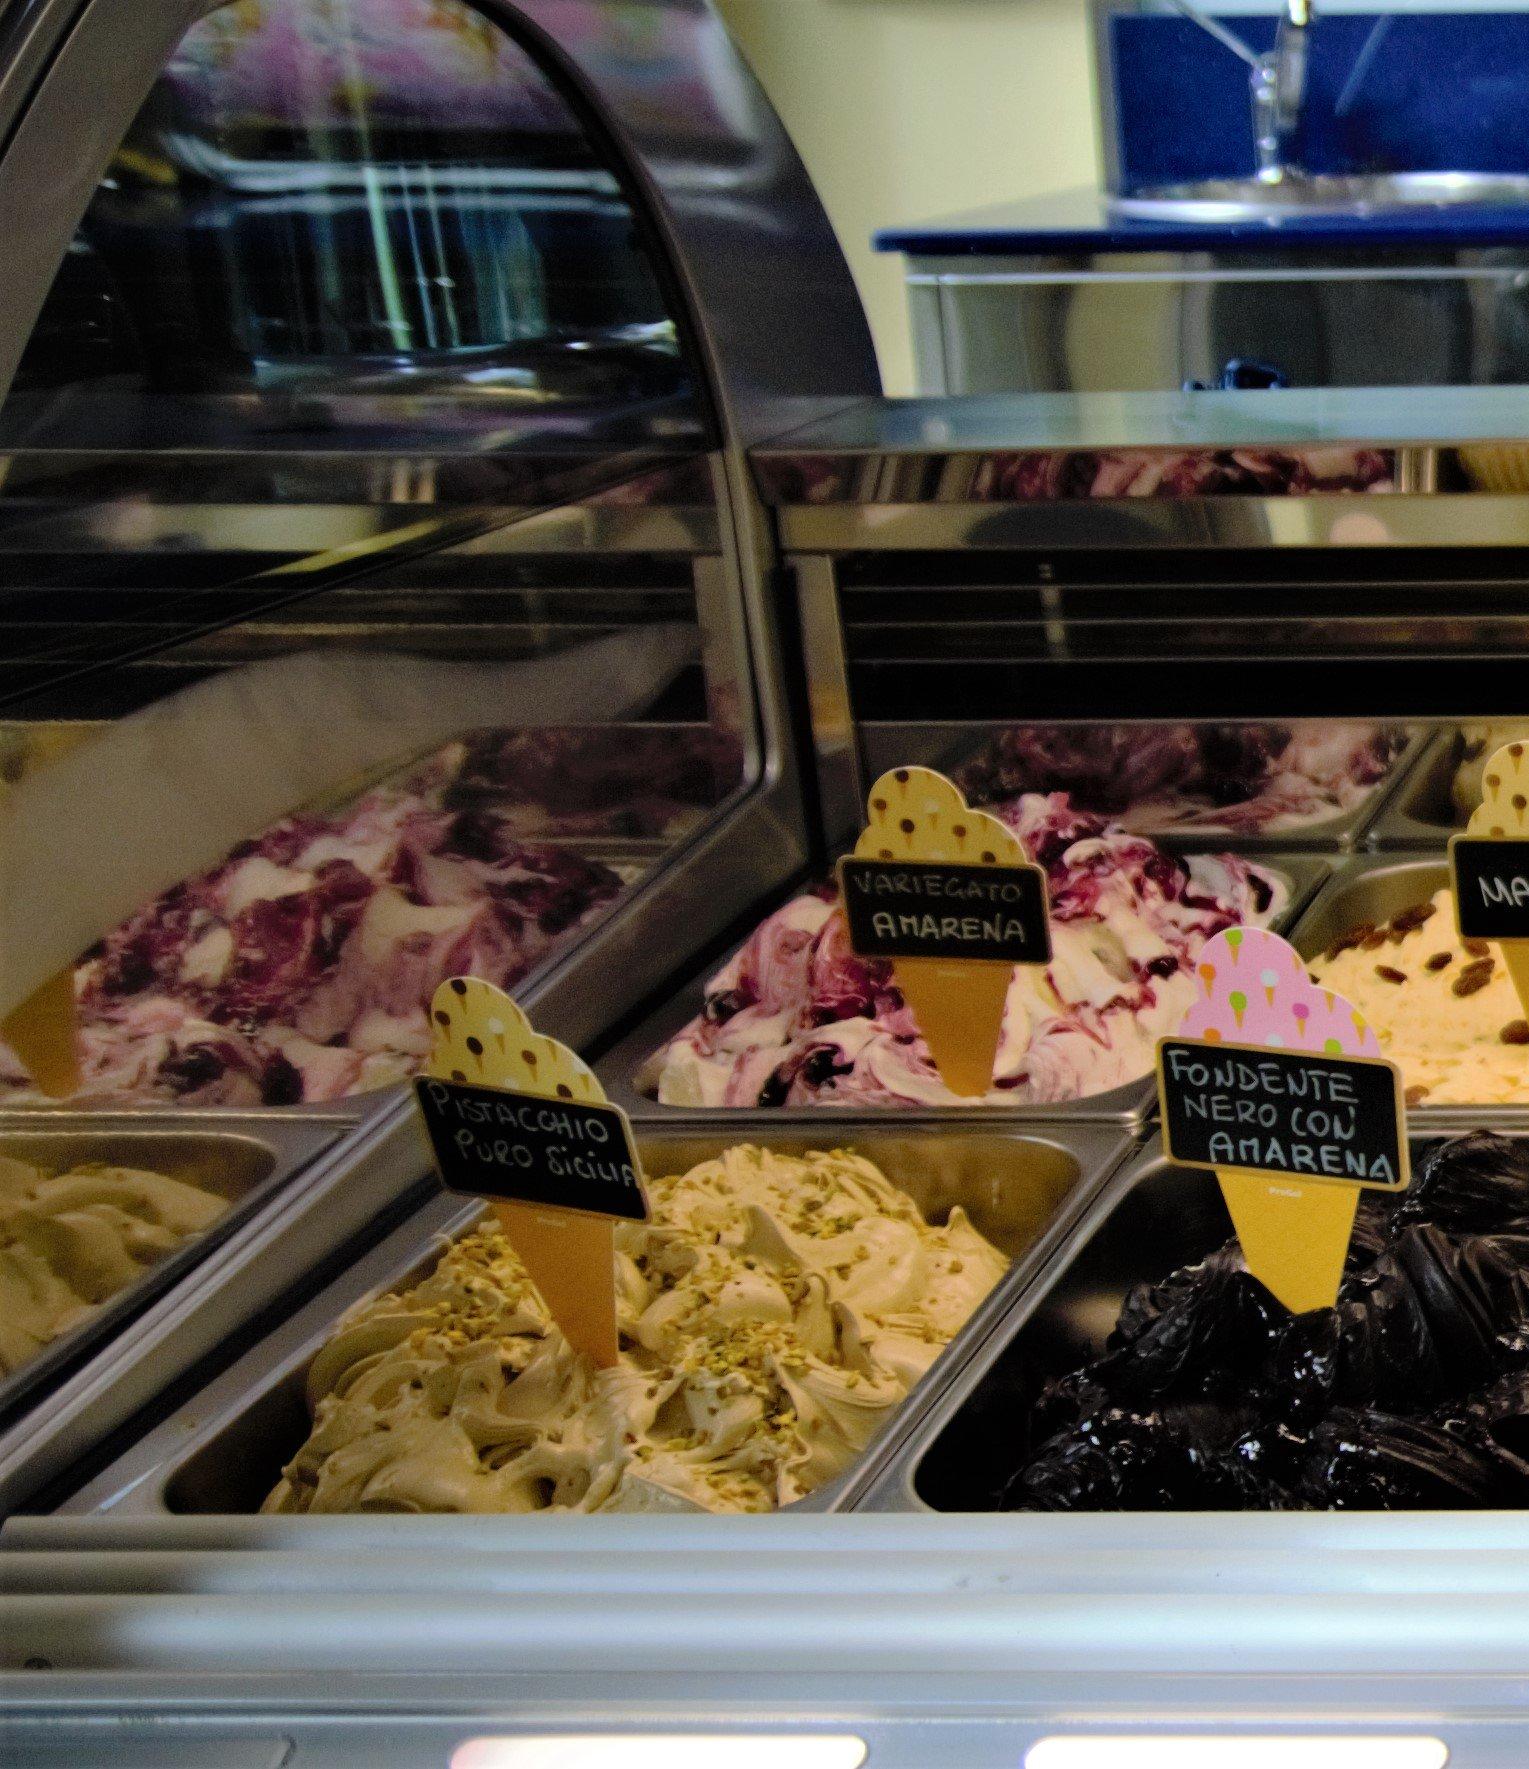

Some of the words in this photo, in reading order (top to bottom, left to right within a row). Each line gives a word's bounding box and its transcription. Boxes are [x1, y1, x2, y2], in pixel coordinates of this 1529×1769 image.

[853, 871, 1022, 902] VARIEGATO
[872, 911, 1026, 943] AMARENA
[1167, 1050, 1359, 1104] FONDENTE
[427, 1081, 609, 1143] PISTACCHIO
[1184, 1094, 1279, 1128] NERO
[1290, 1105, 1356, 1140] CON
[454, 1128, 533, 1168] PURO
[1208, 1131, 1396, 1185] AMARENA
